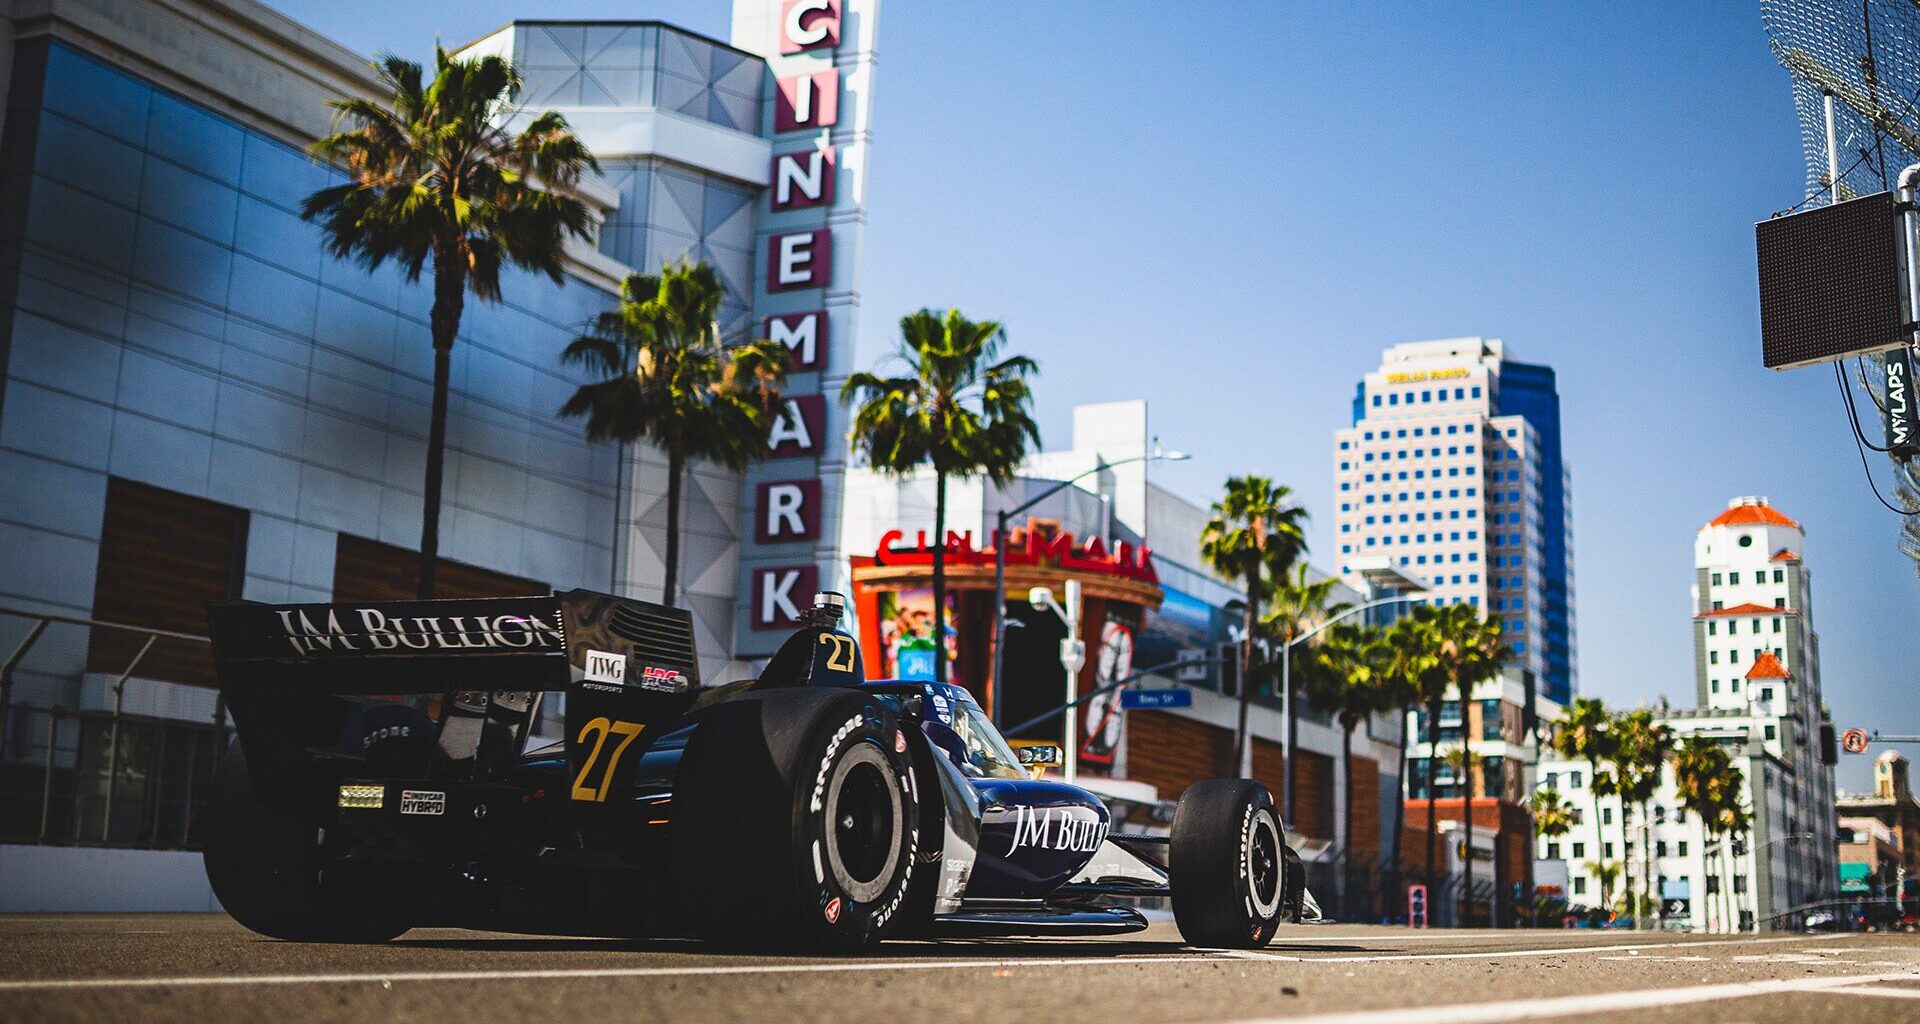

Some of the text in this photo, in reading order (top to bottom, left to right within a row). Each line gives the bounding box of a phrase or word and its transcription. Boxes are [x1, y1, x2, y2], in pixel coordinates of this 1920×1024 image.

[761, 0, 828, 625] CINEMARK
[1887, 362, 1909, 444] MYLAPS
[877, 527, 1159, 584] CINEMARK
[275, 608, 561, 656] JM BULLION
[819, 632, 855, 672] 27
[583, 683, 623, 694] MOTORSPORTS
[590, 656, 622, 679] TWG
[641, 666, 680, 689] HRC
[571, 716, 646, 802] 27
[810, 714, 864, 814] Firestone
[1005, 804, 1049, 858] JM
[1240, 803, 1253, 879] Firestone
[876, 827, 920, 928] Firestone
